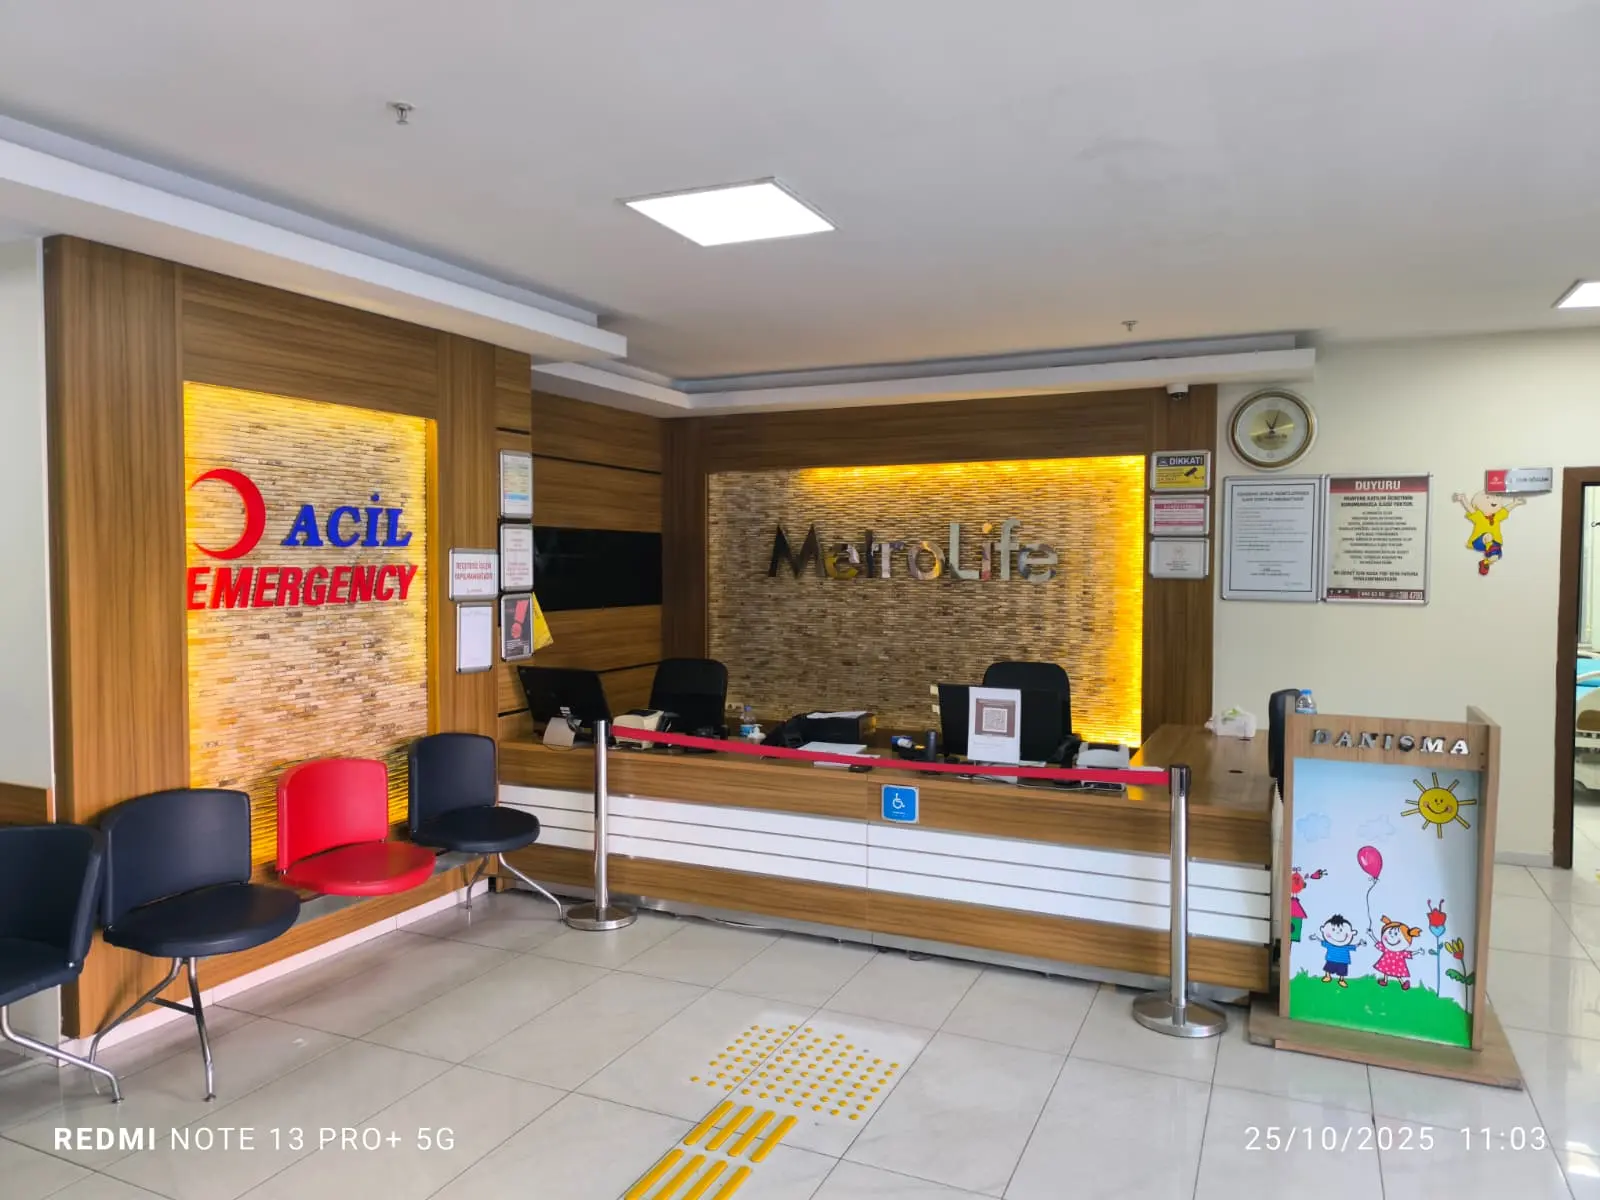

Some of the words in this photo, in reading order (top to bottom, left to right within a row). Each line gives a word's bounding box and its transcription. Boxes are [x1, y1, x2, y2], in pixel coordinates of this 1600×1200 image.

[1355, 480, 1401, 491] DUYURU
[281, 491, 413, 547] ACİL
[767, 517, 1058, 584] MetroLife
[187, 564, 419, 611] EMERGENCY
